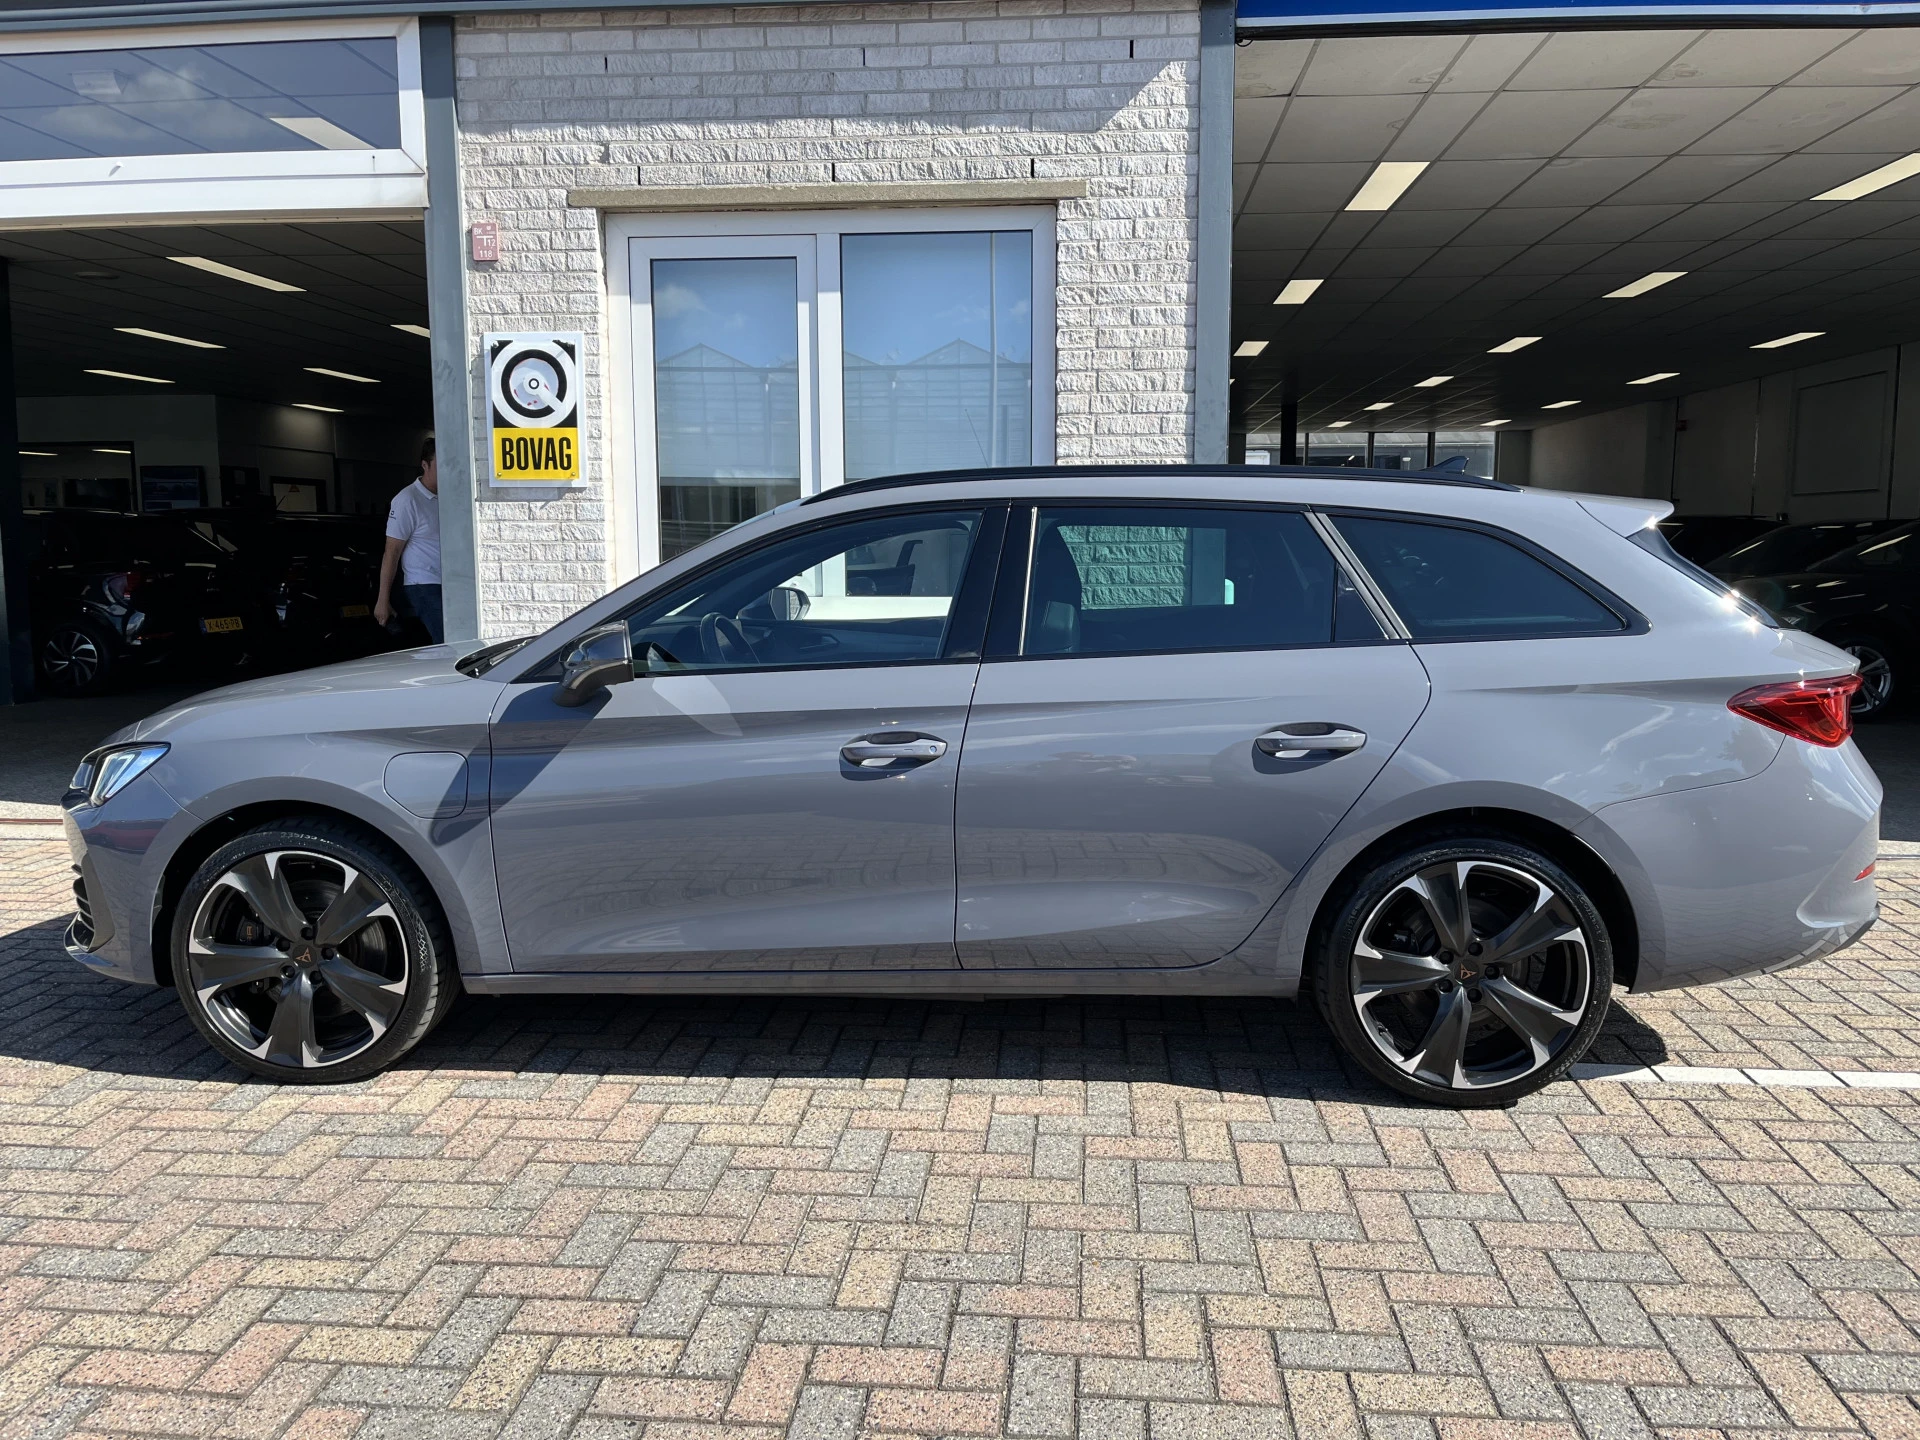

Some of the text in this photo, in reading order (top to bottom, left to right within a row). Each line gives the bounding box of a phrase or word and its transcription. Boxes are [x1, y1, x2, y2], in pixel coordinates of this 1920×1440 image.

[473, 227, 483, 235] BK
[479, 249, 493, 258] 118
[501, 436, 572, 471] BOVAG
